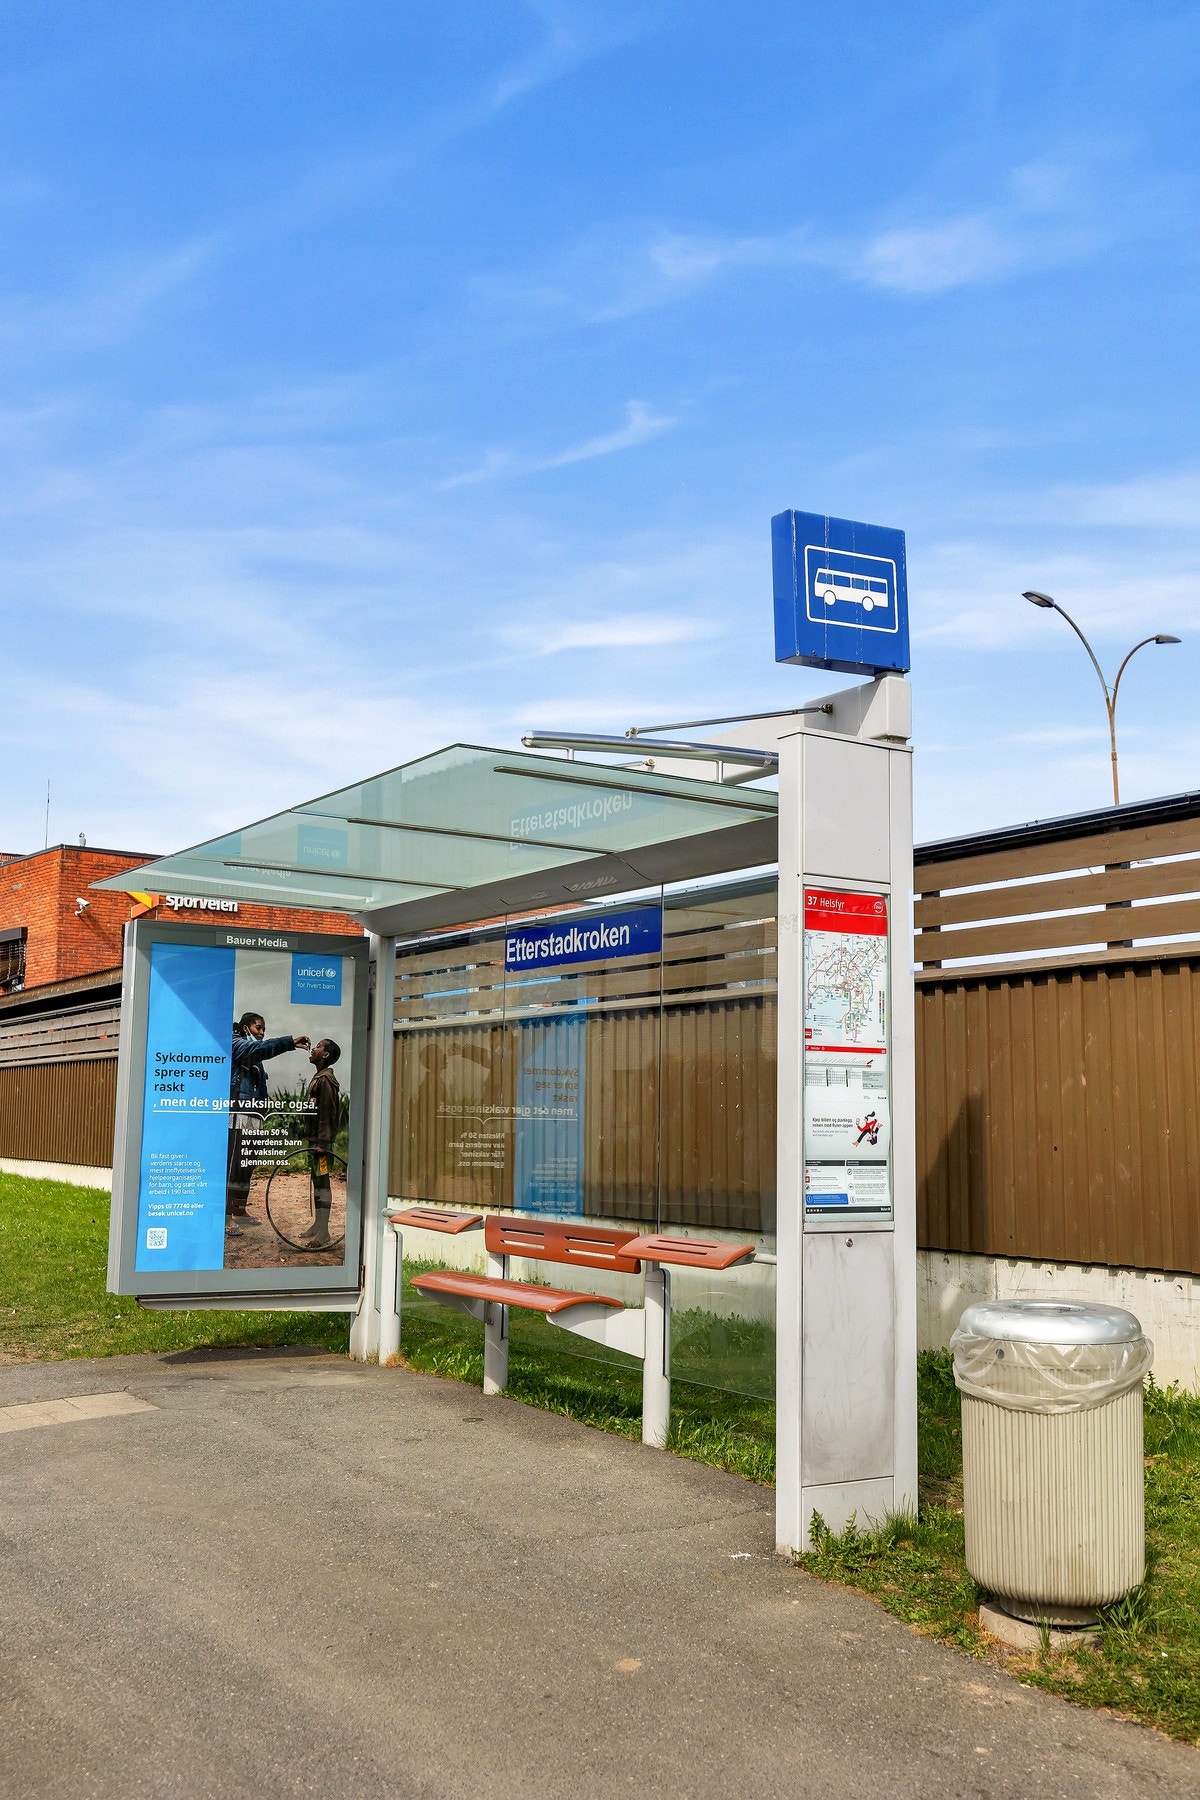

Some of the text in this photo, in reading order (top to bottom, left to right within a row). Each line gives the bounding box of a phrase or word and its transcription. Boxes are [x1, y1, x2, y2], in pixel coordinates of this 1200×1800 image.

[807, 896, 845, 911] 37 Helsfyr
[226, 935, 288, 949] Bauer Media
[506, 922, 630, 962] Etterstadkroken
[297, 967, 325, 977] unicef
[155, 1052, 227, 1065] Sykdommer
[154, 1068, 209, 1080] sprer seg
[154, 1082, 185, 1093] raskt
[160, 1098, 187, 1107] men
[189, 1097, 209, 1107] det
[212, 1098, 235, 1110] gjør
[239, 1098, 286, 1109] vaksiner
[241, 1148, 252, 1156] får
[240, 1158, 275, 1167] gjennom
